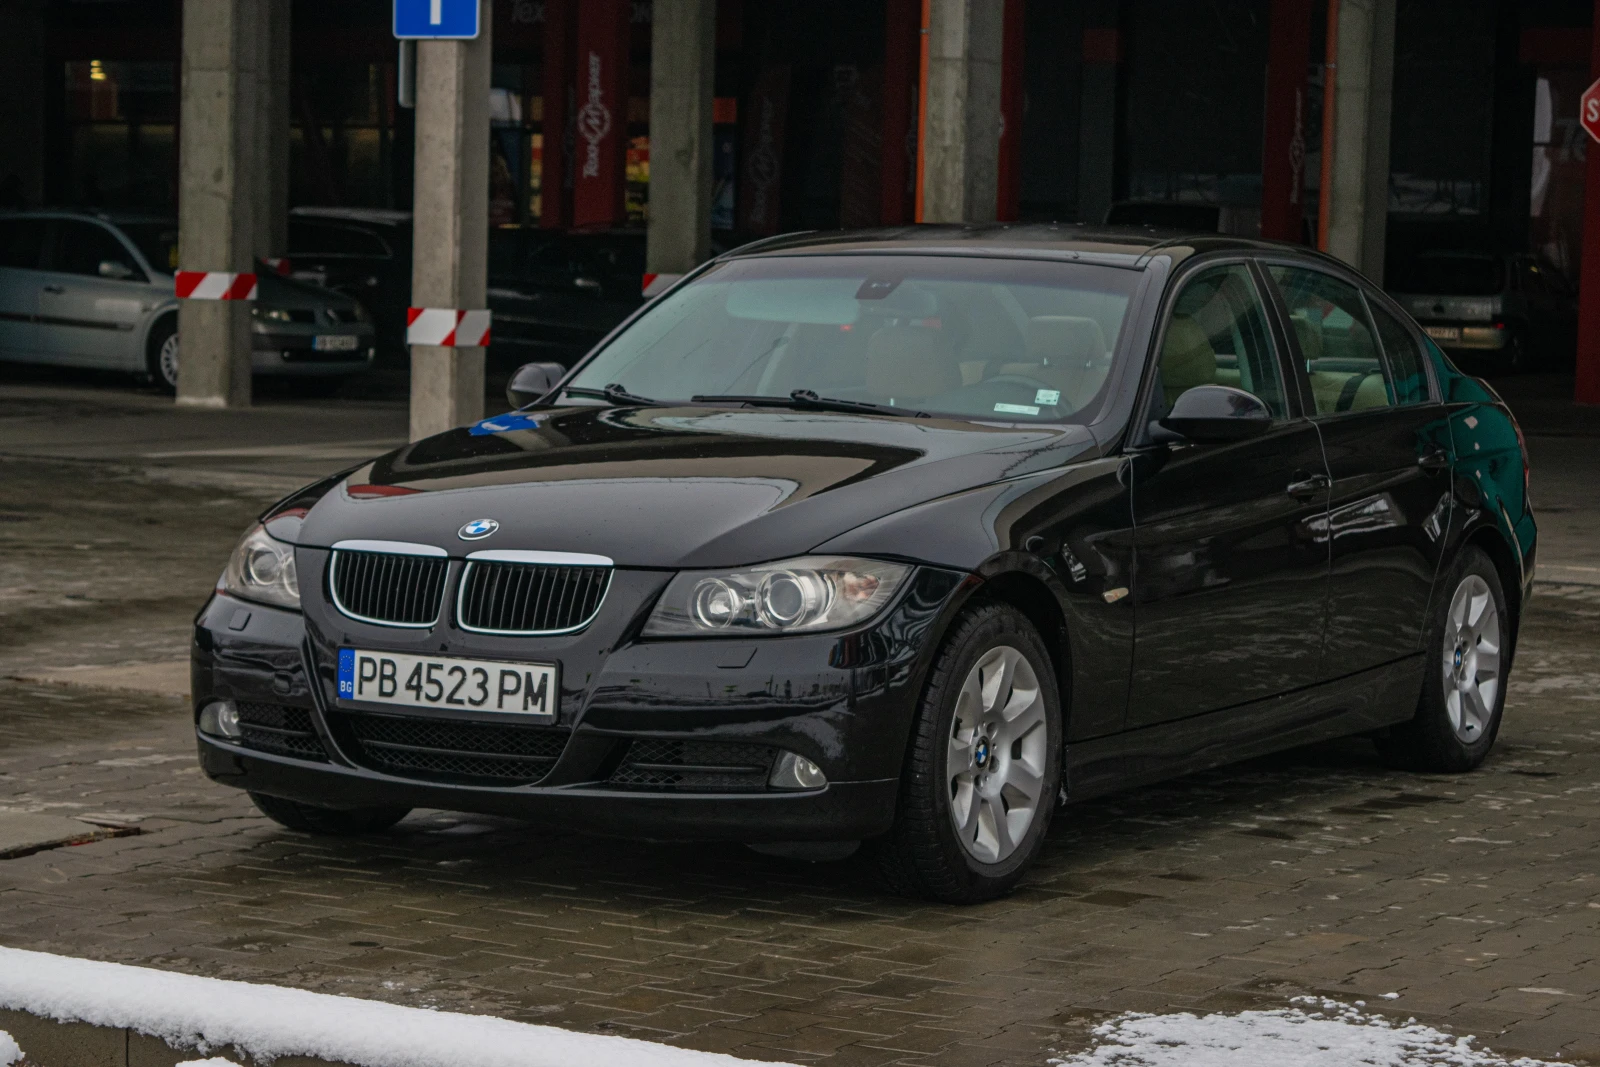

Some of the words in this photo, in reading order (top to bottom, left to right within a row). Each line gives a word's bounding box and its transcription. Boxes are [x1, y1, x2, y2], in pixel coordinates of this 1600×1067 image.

[340, 680, 353, 693] BG
[358, 656, 398, 698] PB
[405, 661, 489, 706] 4523
[497, 669, 548, 712] PM
